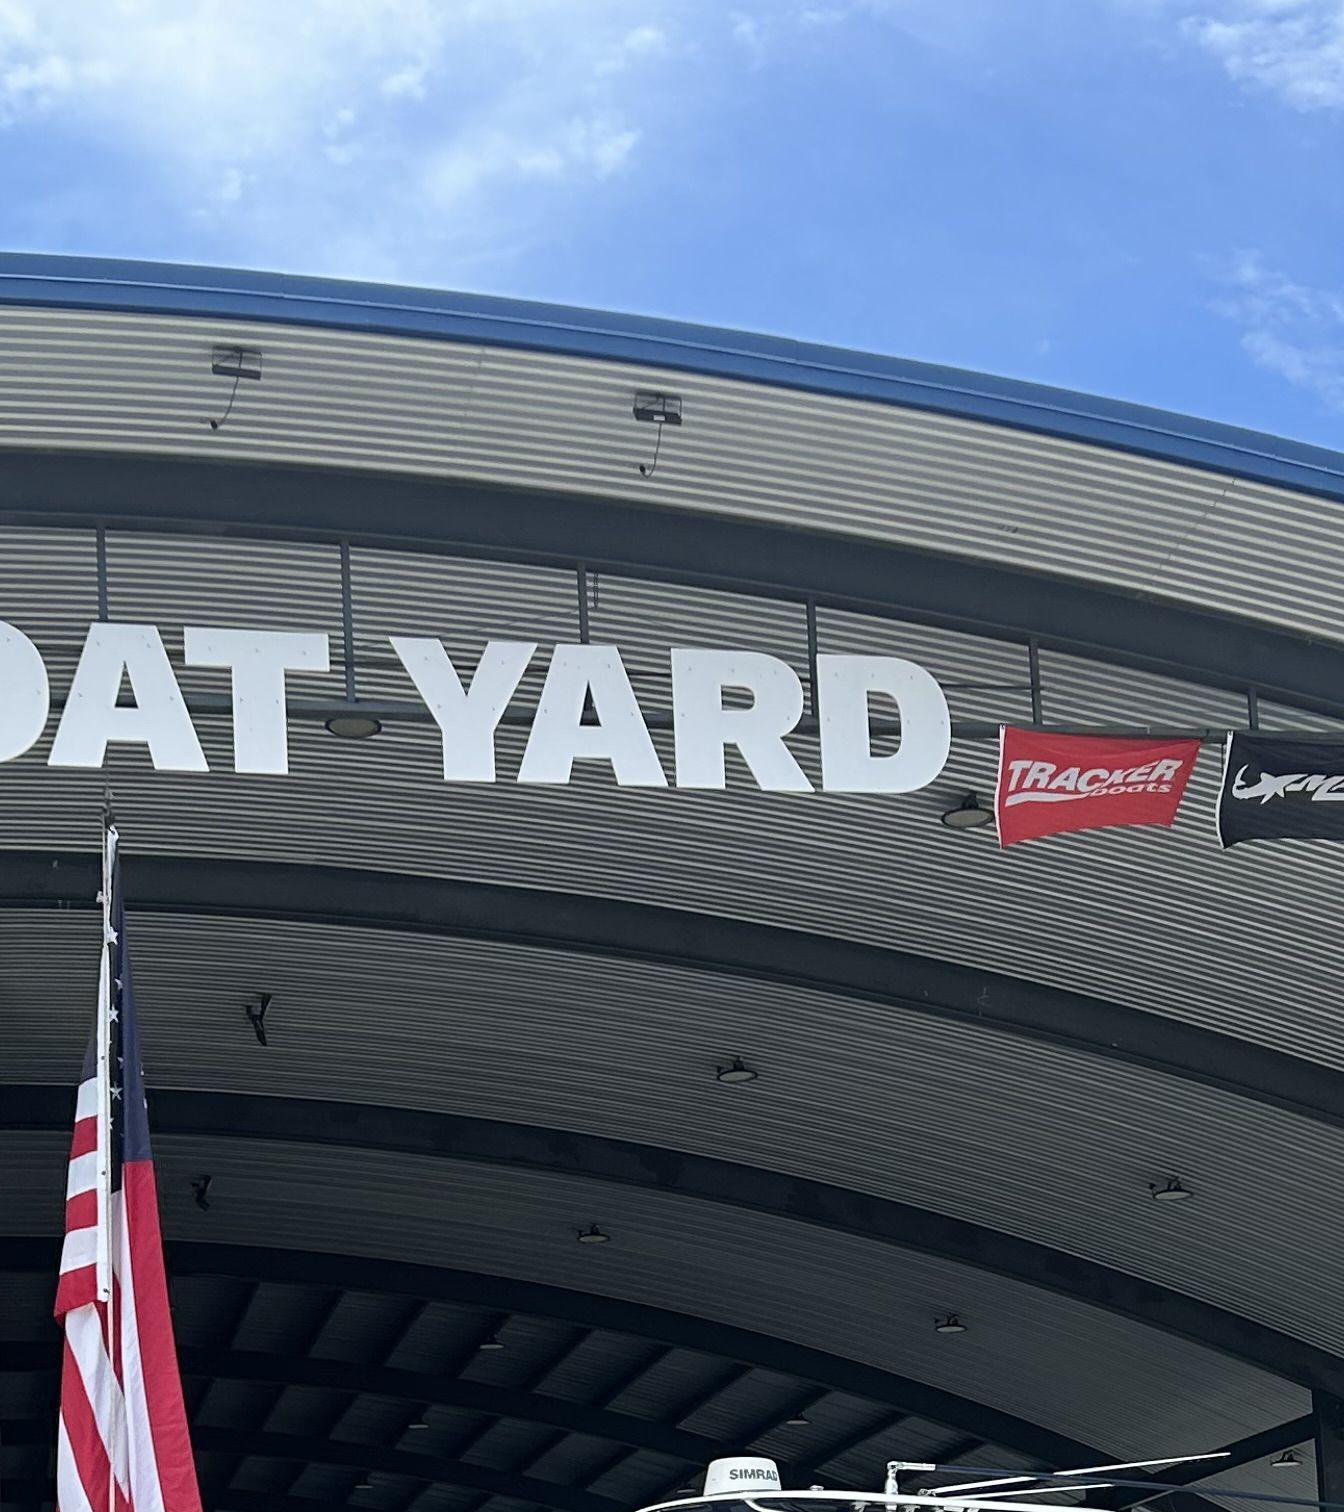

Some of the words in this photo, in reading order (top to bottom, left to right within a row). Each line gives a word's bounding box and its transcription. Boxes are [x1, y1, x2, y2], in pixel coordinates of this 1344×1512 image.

[388, 635, 952, 794] YARD
[1007, 758, 1184, 794] TRACKER
[729, 1468, 778, 1482] SIMRAD
